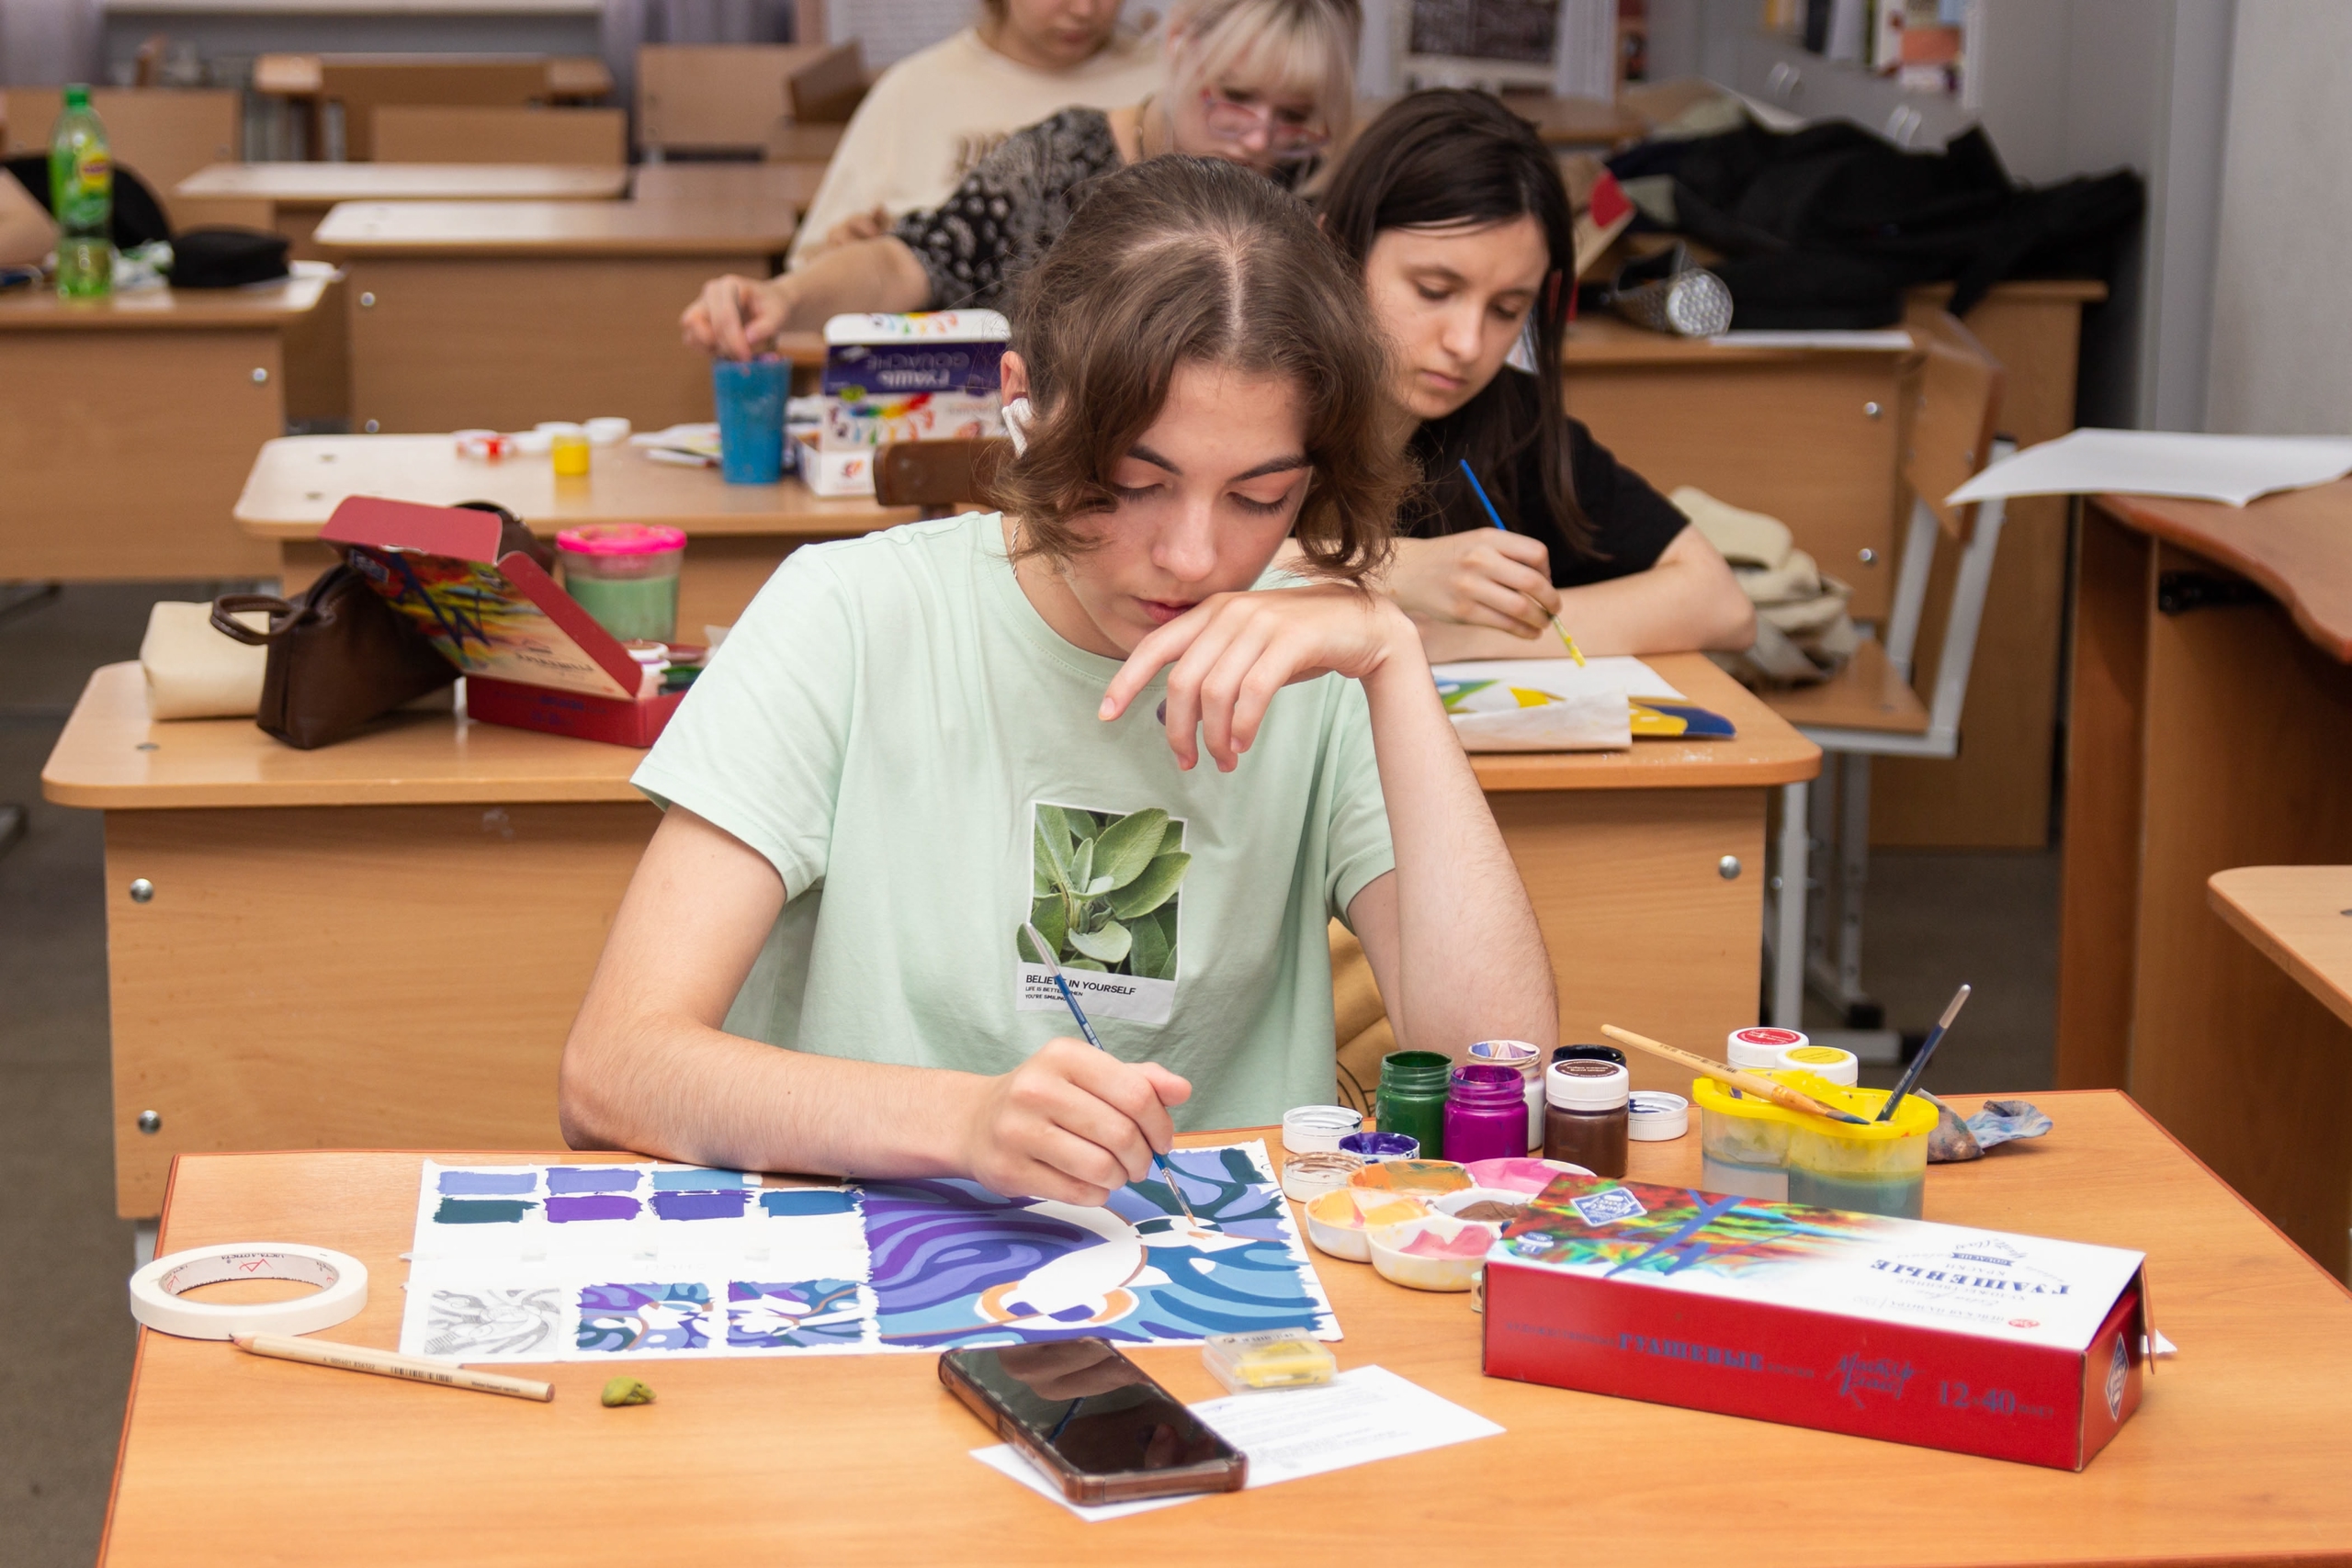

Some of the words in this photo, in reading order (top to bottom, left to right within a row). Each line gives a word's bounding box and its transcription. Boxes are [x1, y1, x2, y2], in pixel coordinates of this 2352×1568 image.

[1025, 975, 1067, 986] BELIE
[1069, 979, 1080, 989] IN
[1082, 981, 1136, 996] YOURSELF
[1870, 1258, 2072, 1296] ГУАШЕВЫЕ
[1618, 1331, 1764, 1371] ГУАШЕВЫЕ
